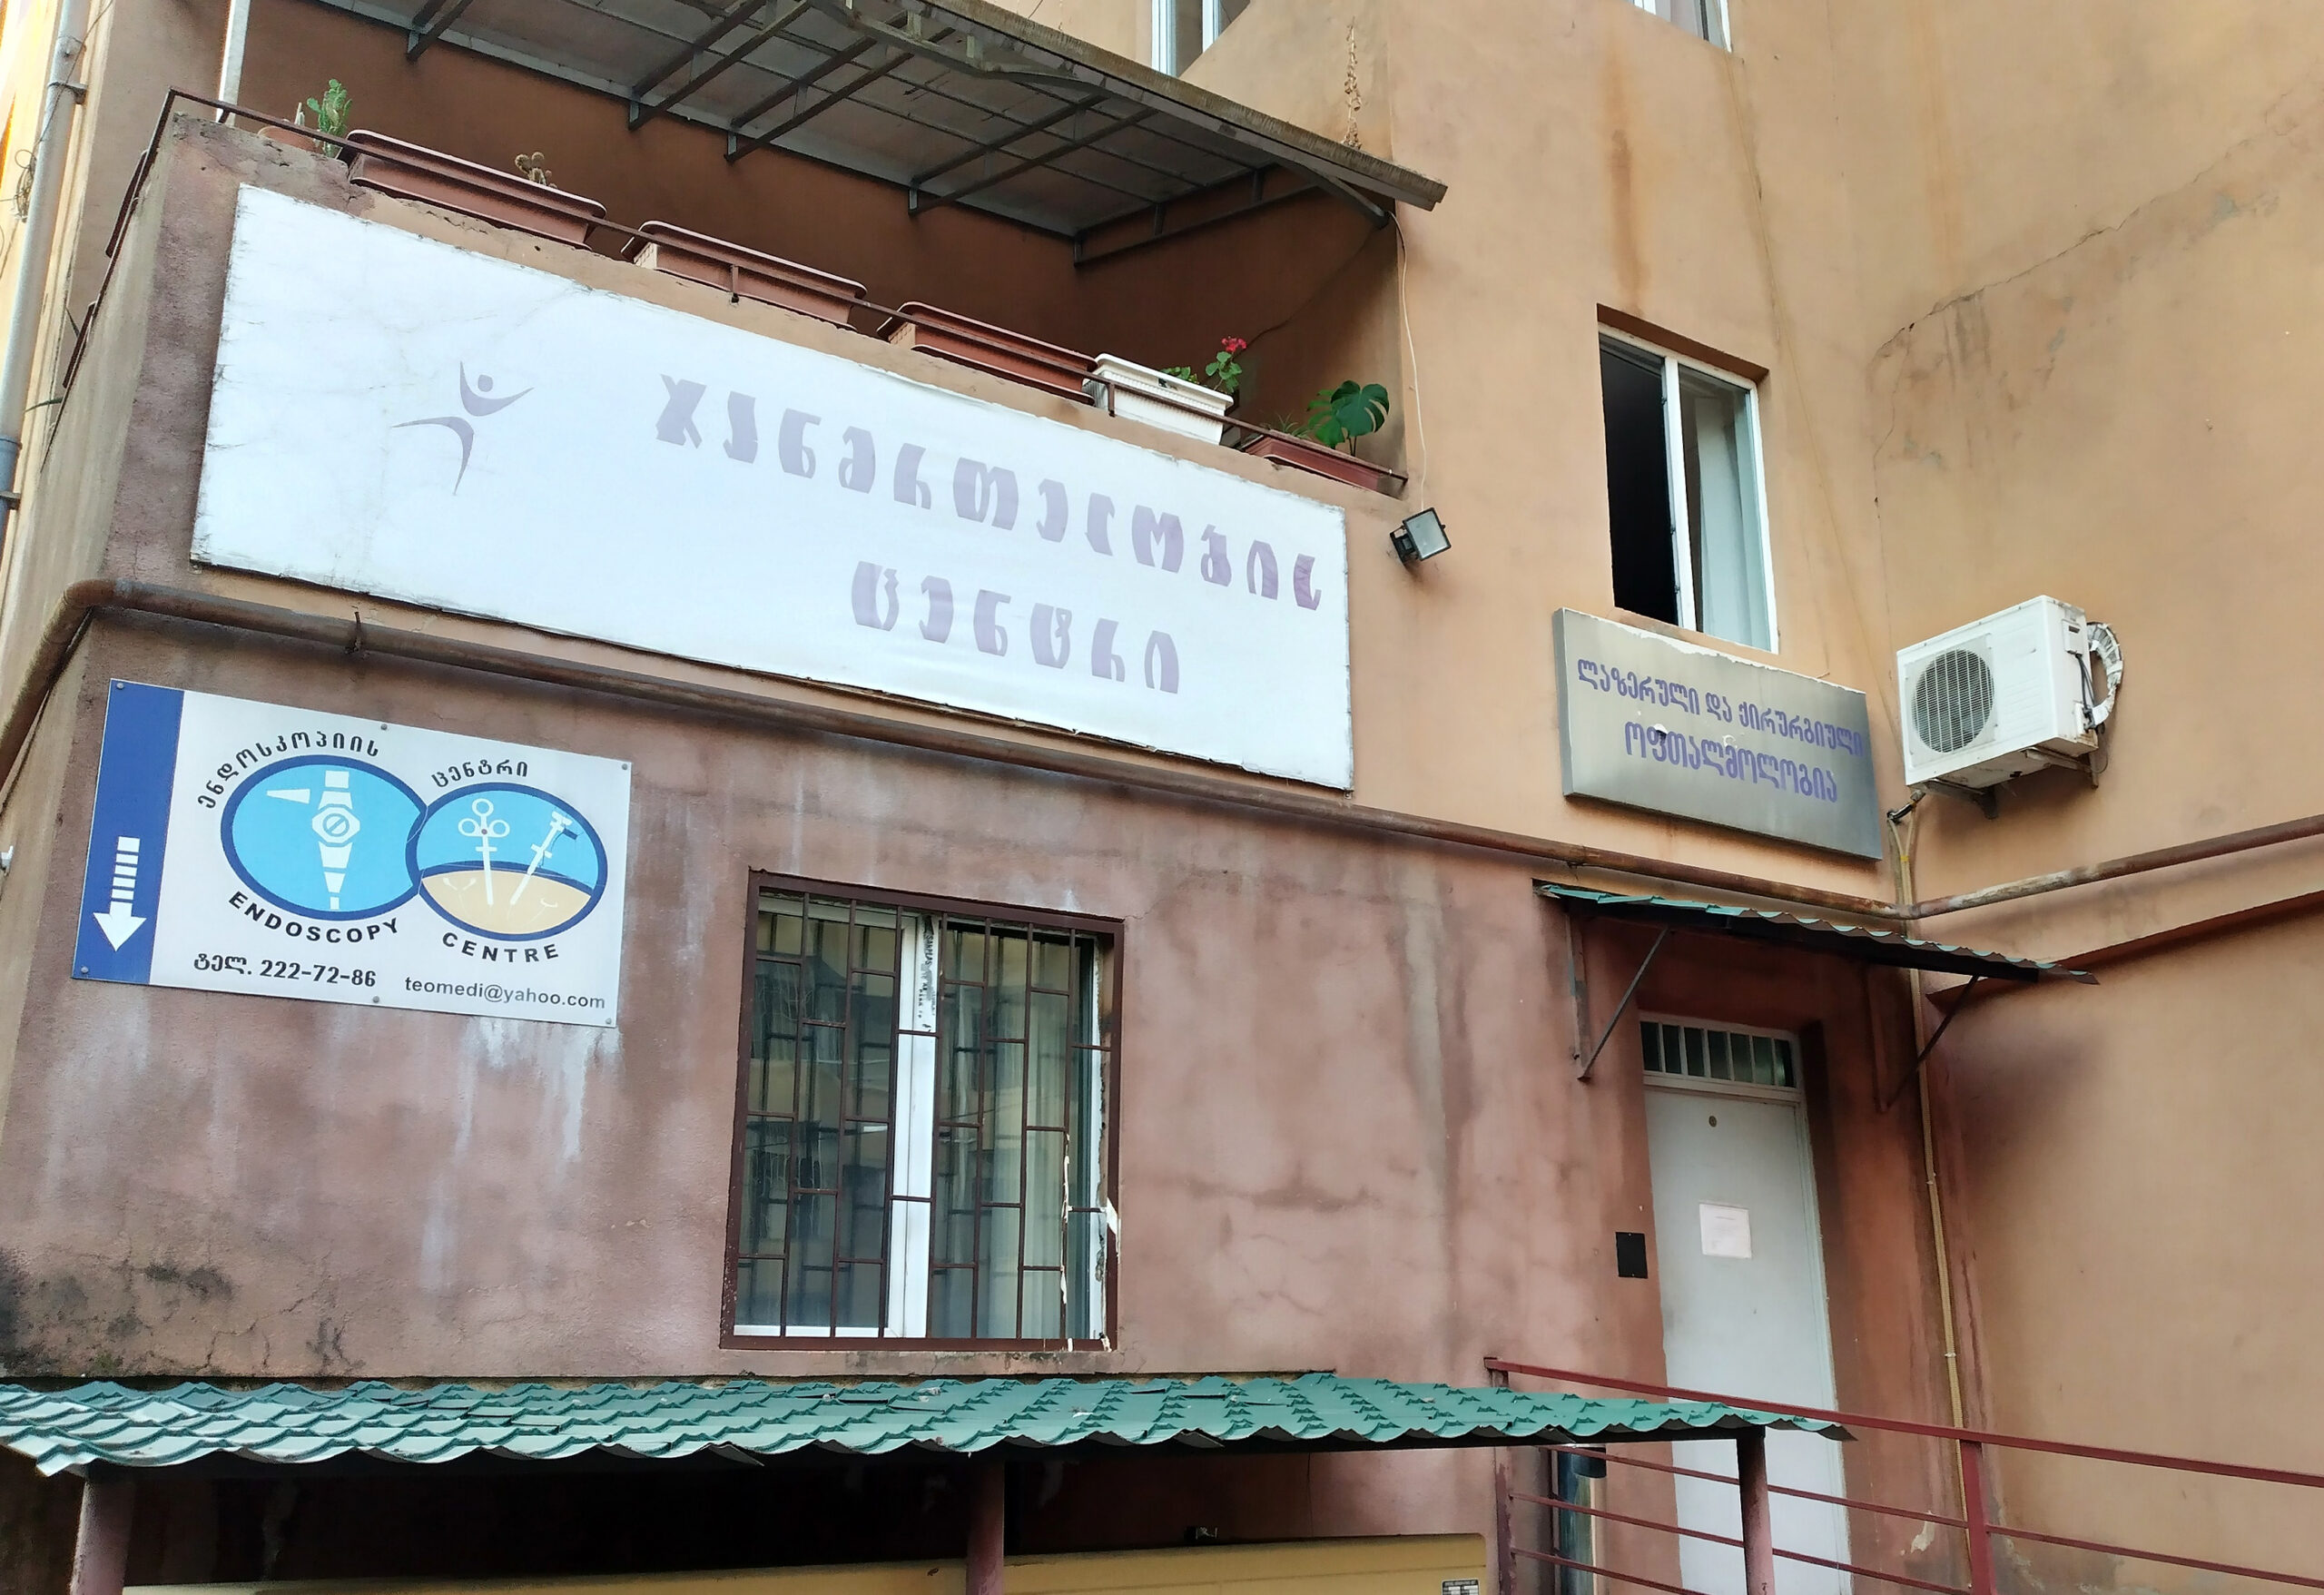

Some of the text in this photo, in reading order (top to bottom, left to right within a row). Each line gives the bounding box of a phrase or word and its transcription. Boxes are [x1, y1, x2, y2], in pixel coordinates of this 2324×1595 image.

[655, 374, 1322, 611] ჯანმრთელობის
[851, 561, 1180, 694] ცენტრი
[1577, 658, 1864, 757] ლაზერული და ქირურგიული
[198, 730, 528, 809] ენდოსკოპიის ცენტრი
[1625, 721, 1837, 802] ოფთალმოლოგია
[228, 891, 558, 962] ENDOSCOPY CENTRE
[193, 953, 377, 988] ტელ. 222-72-86
[405, 977, 606, 1009] teomedi@yahoo.com
